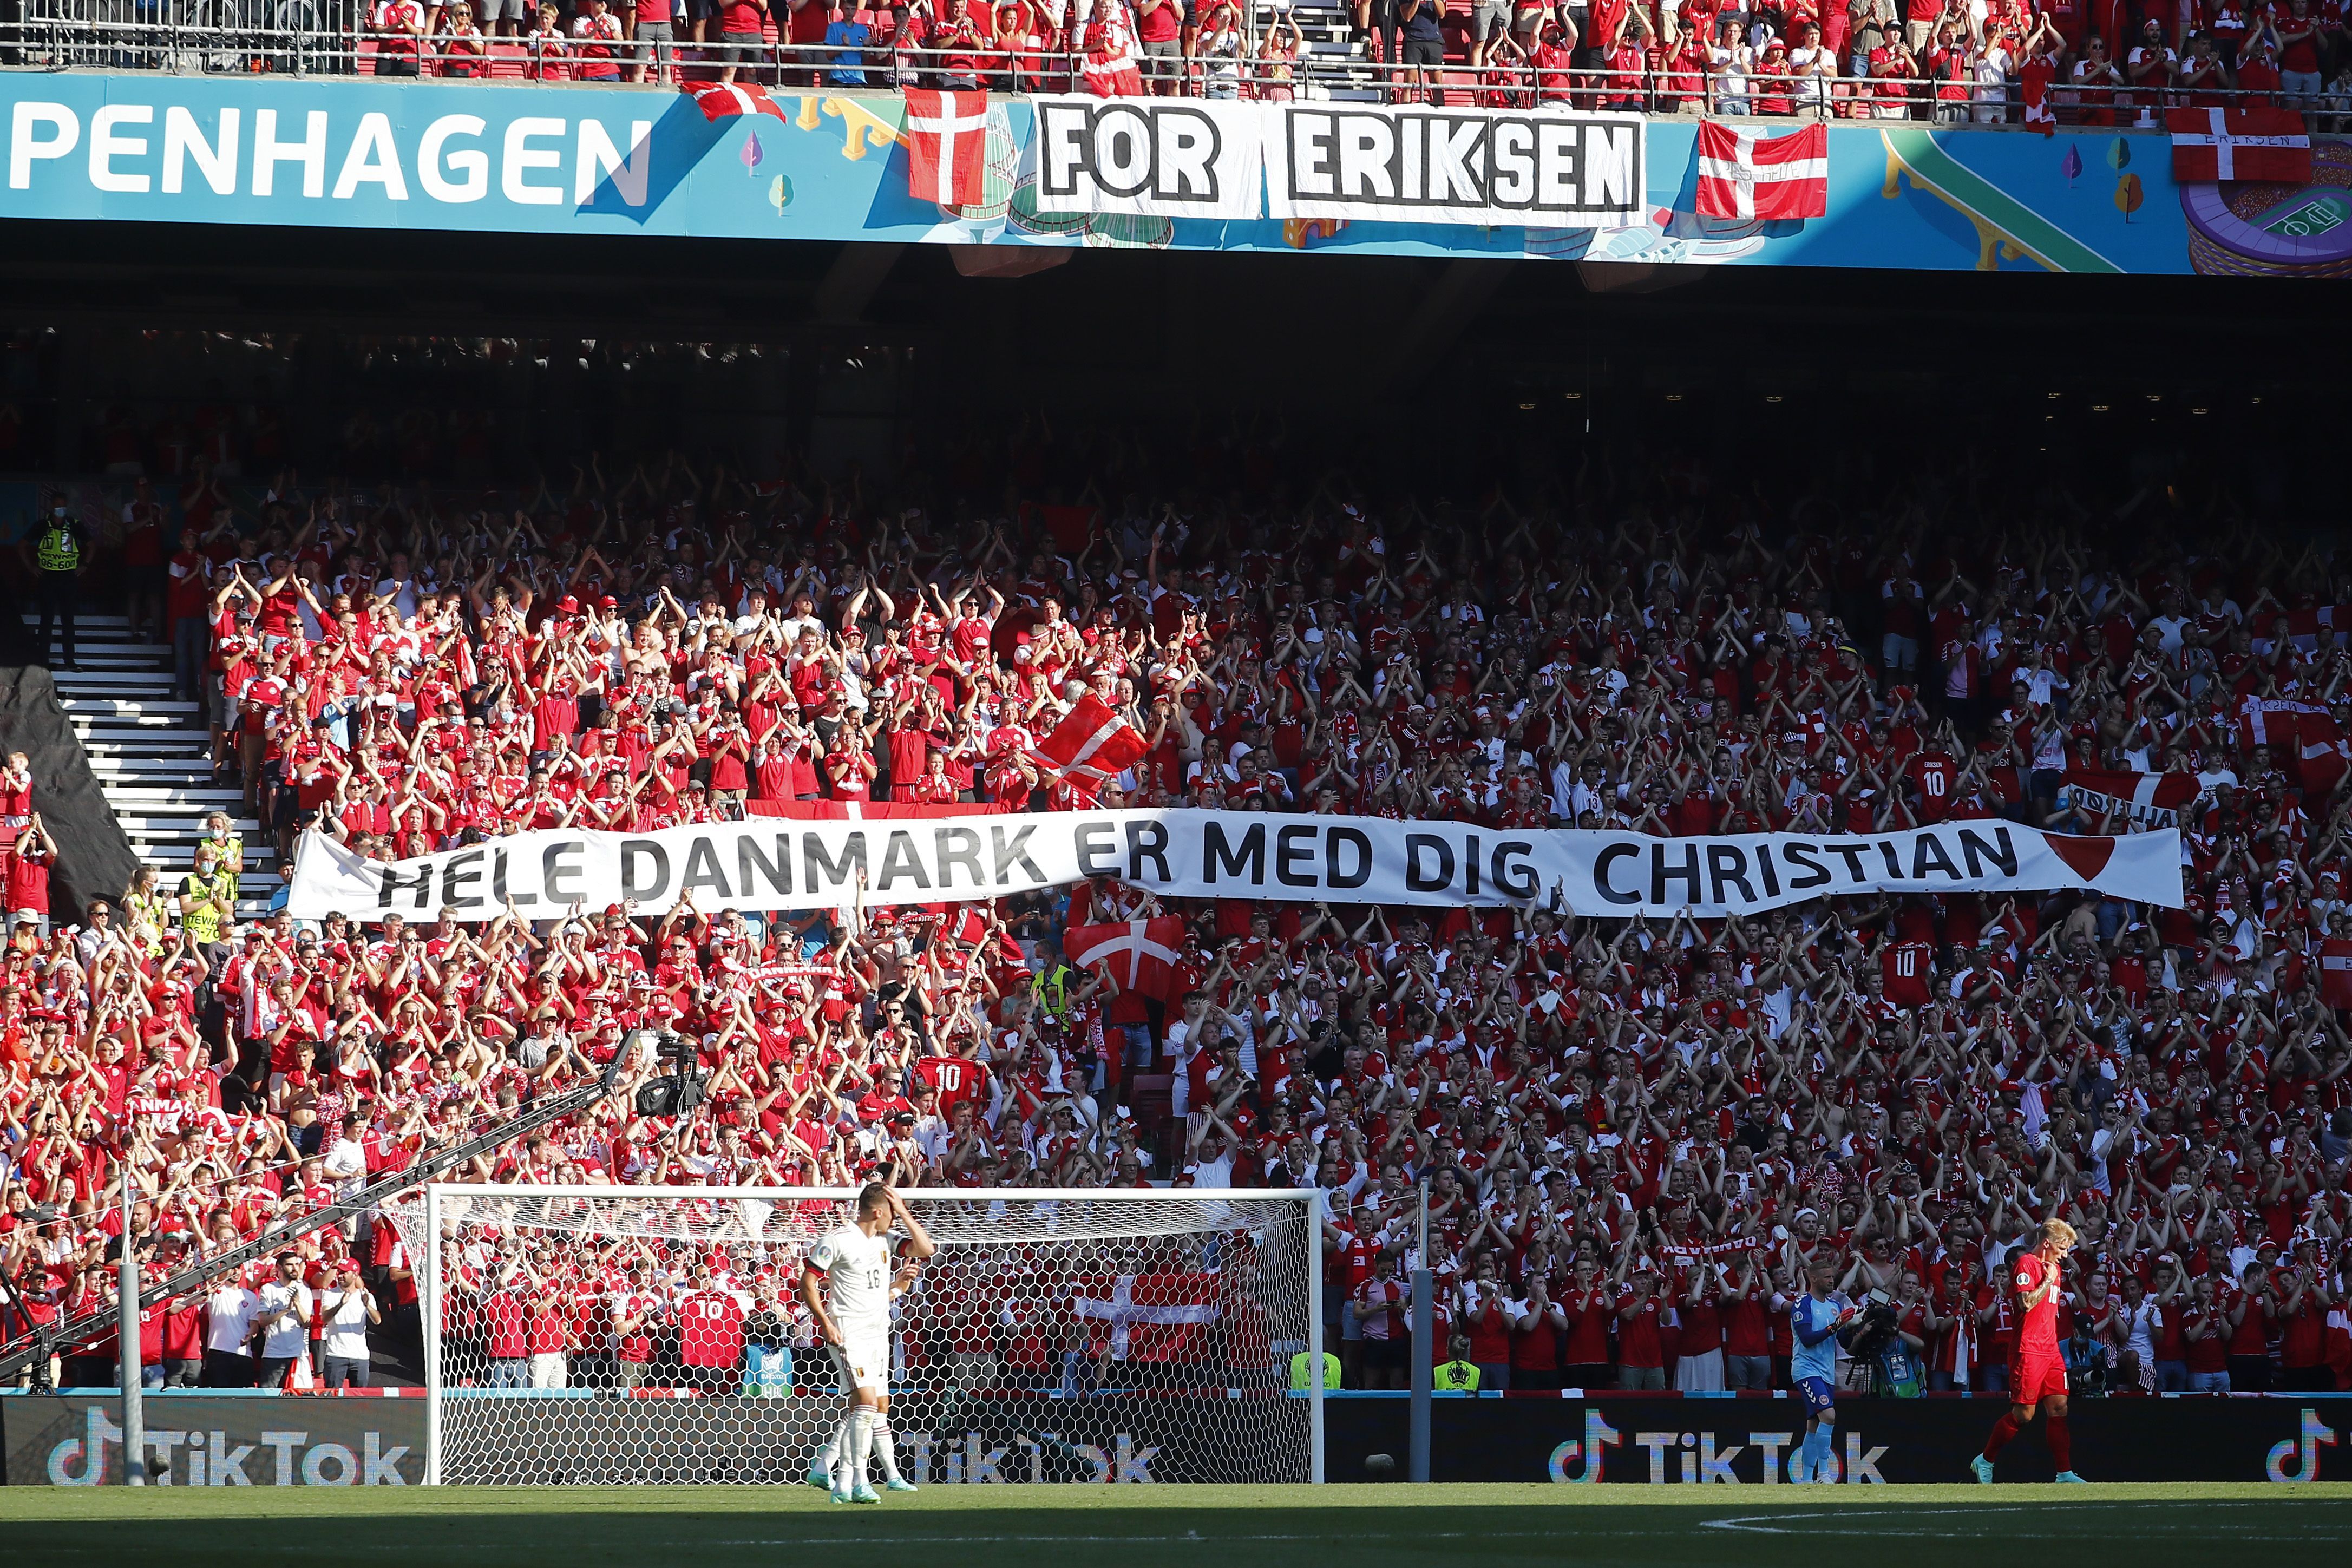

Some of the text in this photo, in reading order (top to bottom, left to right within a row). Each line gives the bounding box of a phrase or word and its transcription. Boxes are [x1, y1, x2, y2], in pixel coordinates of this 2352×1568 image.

[2205, 135, 2290, 145] ERIKSEN
[9, 101, 652, 206] PENHAGEN
[1038, 102, 1640, 212] FOR ERIKSEN
[1923, 771, 1945, 797] 10
[1587, 798, 1598, 810] 13
[379, 841, 587, 908] HELE
[620, 825, 1048, 901] DANMARK
[1074, 819, 1171, 882] ER
[1203, 821, 1373, 888] MED
[1593, 826, 2019, 905] CHRISTIAN
[186, 915, 218, 926] STEWA
[750, 966, 834, 980] DANMARK
[1896, 950, 1915, 976] 10
[936, 1064, 961, 1092] 10
[1663, 1236, 1757, 1255] DANMARK
[867, 1269, 880, 1289] 16
[697, 1300, 723, 1320] 10
[142, 1431, 411, 1485] TikTok
